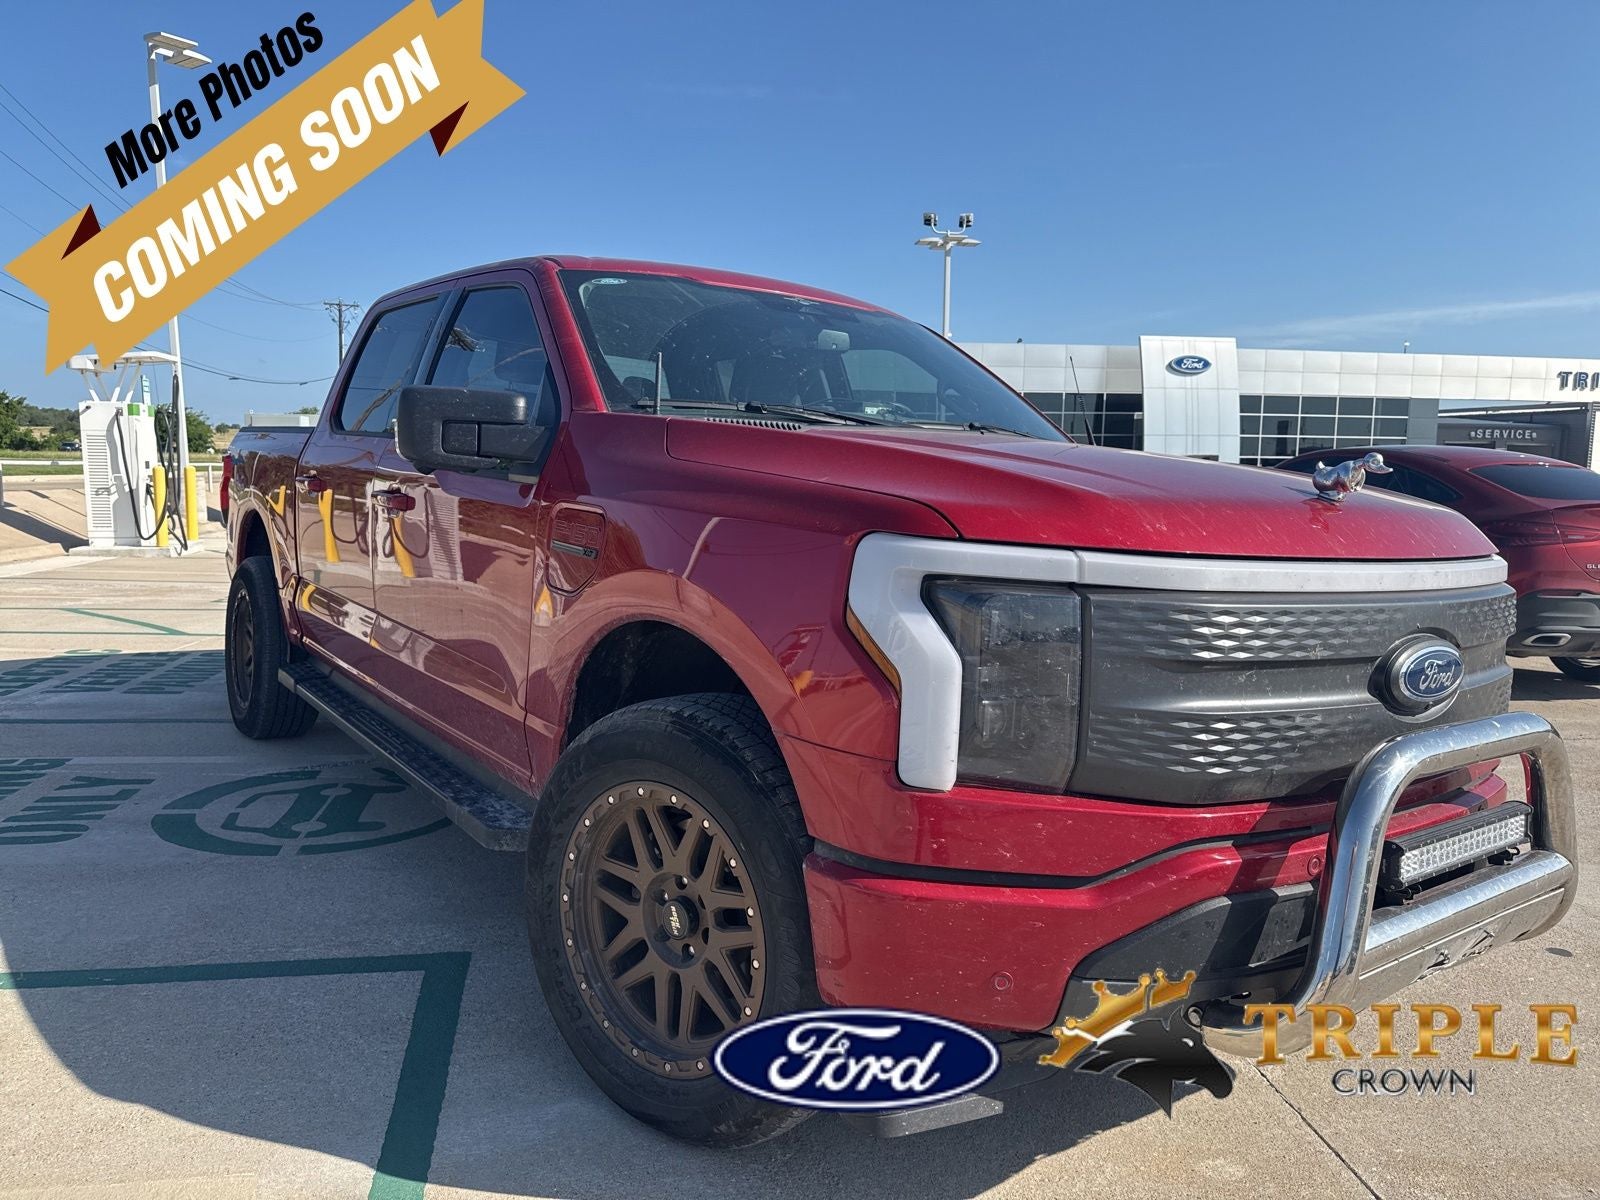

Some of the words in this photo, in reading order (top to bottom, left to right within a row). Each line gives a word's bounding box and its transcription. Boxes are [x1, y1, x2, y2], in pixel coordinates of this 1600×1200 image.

[1557, 370, 1600, 391] TRI
[1476, 429, 1532, 439] SERVICE
[1419, 659, 1455, 690] Ford
[0, 776, 156, 845] ONLY
